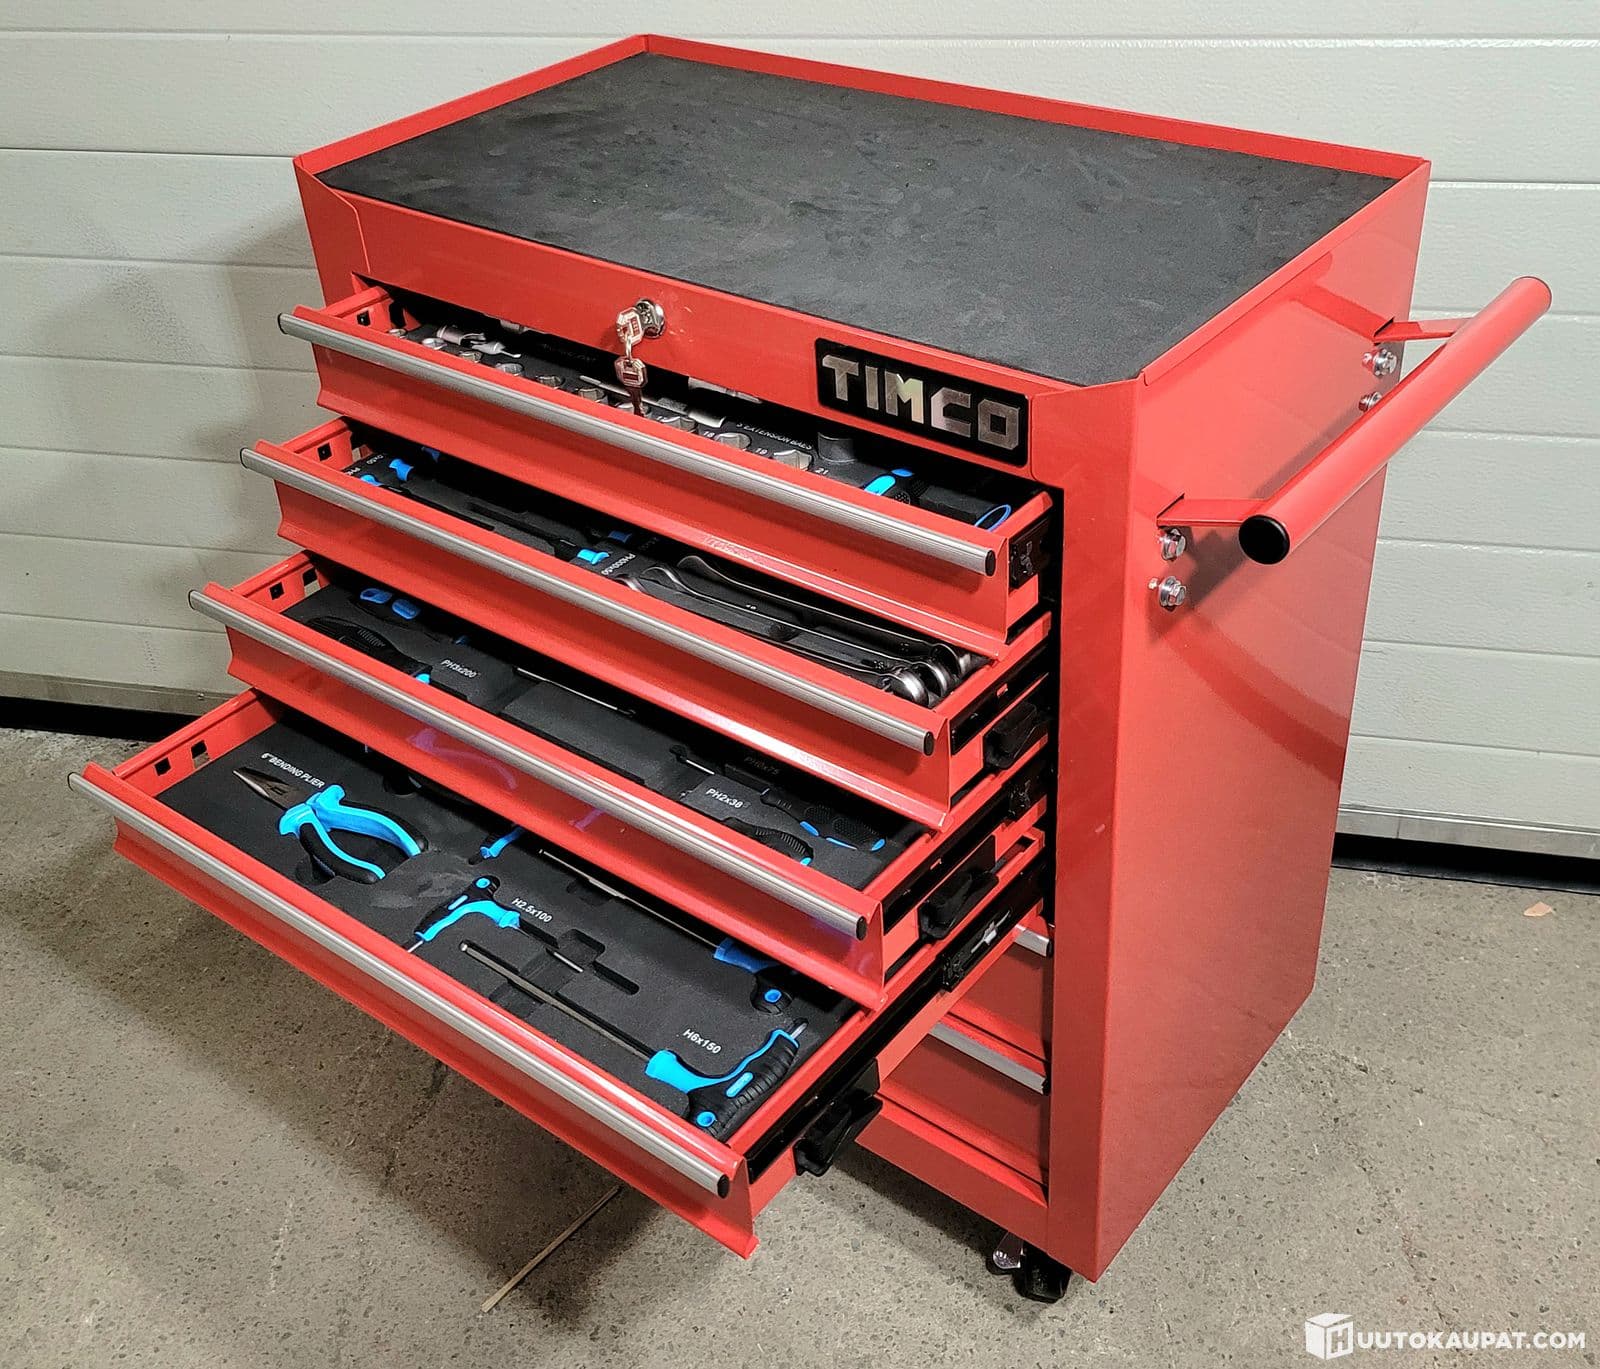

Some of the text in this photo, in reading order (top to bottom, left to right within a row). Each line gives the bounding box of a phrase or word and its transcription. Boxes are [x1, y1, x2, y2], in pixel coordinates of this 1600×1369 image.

[822, 354, 1021, 450] TIMCO
[301, 772, 325, 788] PLIER
[511, 898, 553, 923] H2.5x100
[682, 1028, 722, 1054] H6x150
